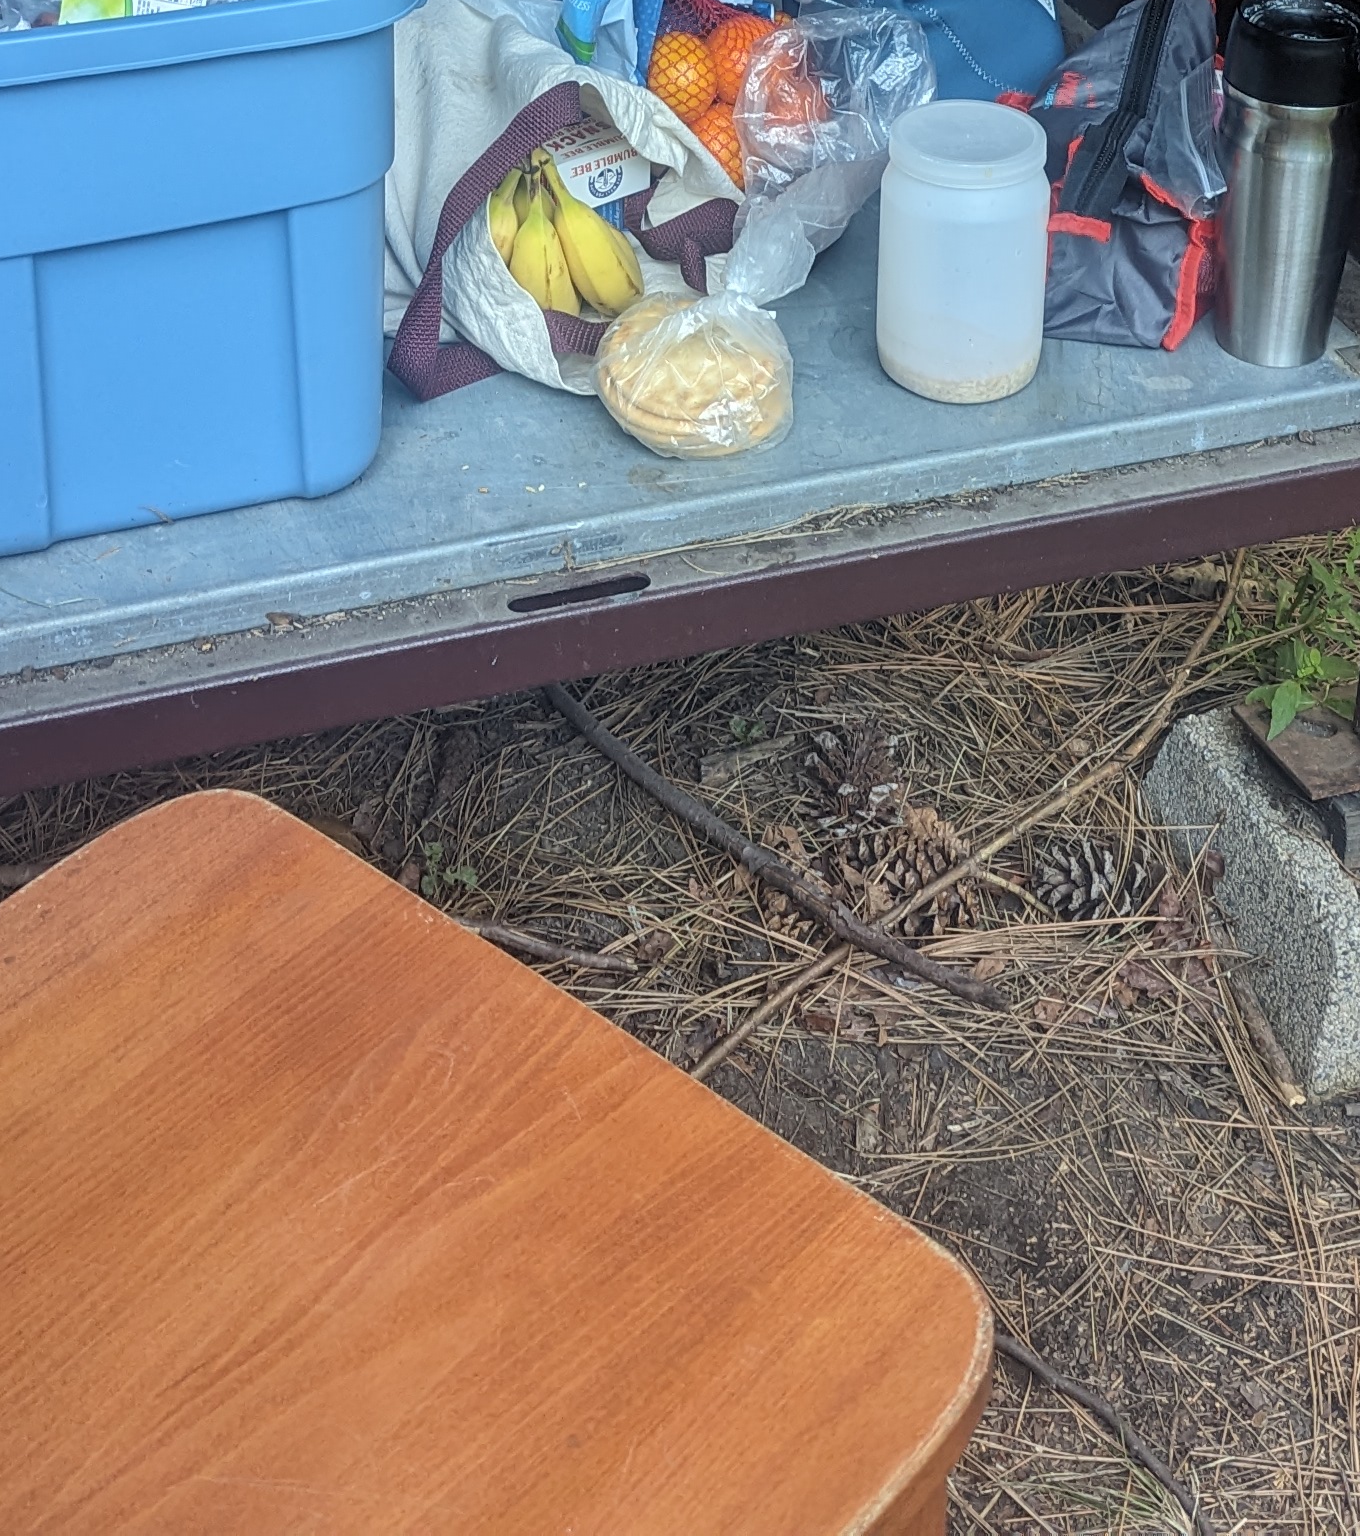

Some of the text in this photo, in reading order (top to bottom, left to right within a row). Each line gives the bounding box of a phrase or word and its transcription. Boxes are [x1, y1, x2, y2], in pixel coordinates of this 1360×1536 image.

[545, 121, 612, 152] SNACK
[571, 147, 638, 178] BUMBLE BEE
